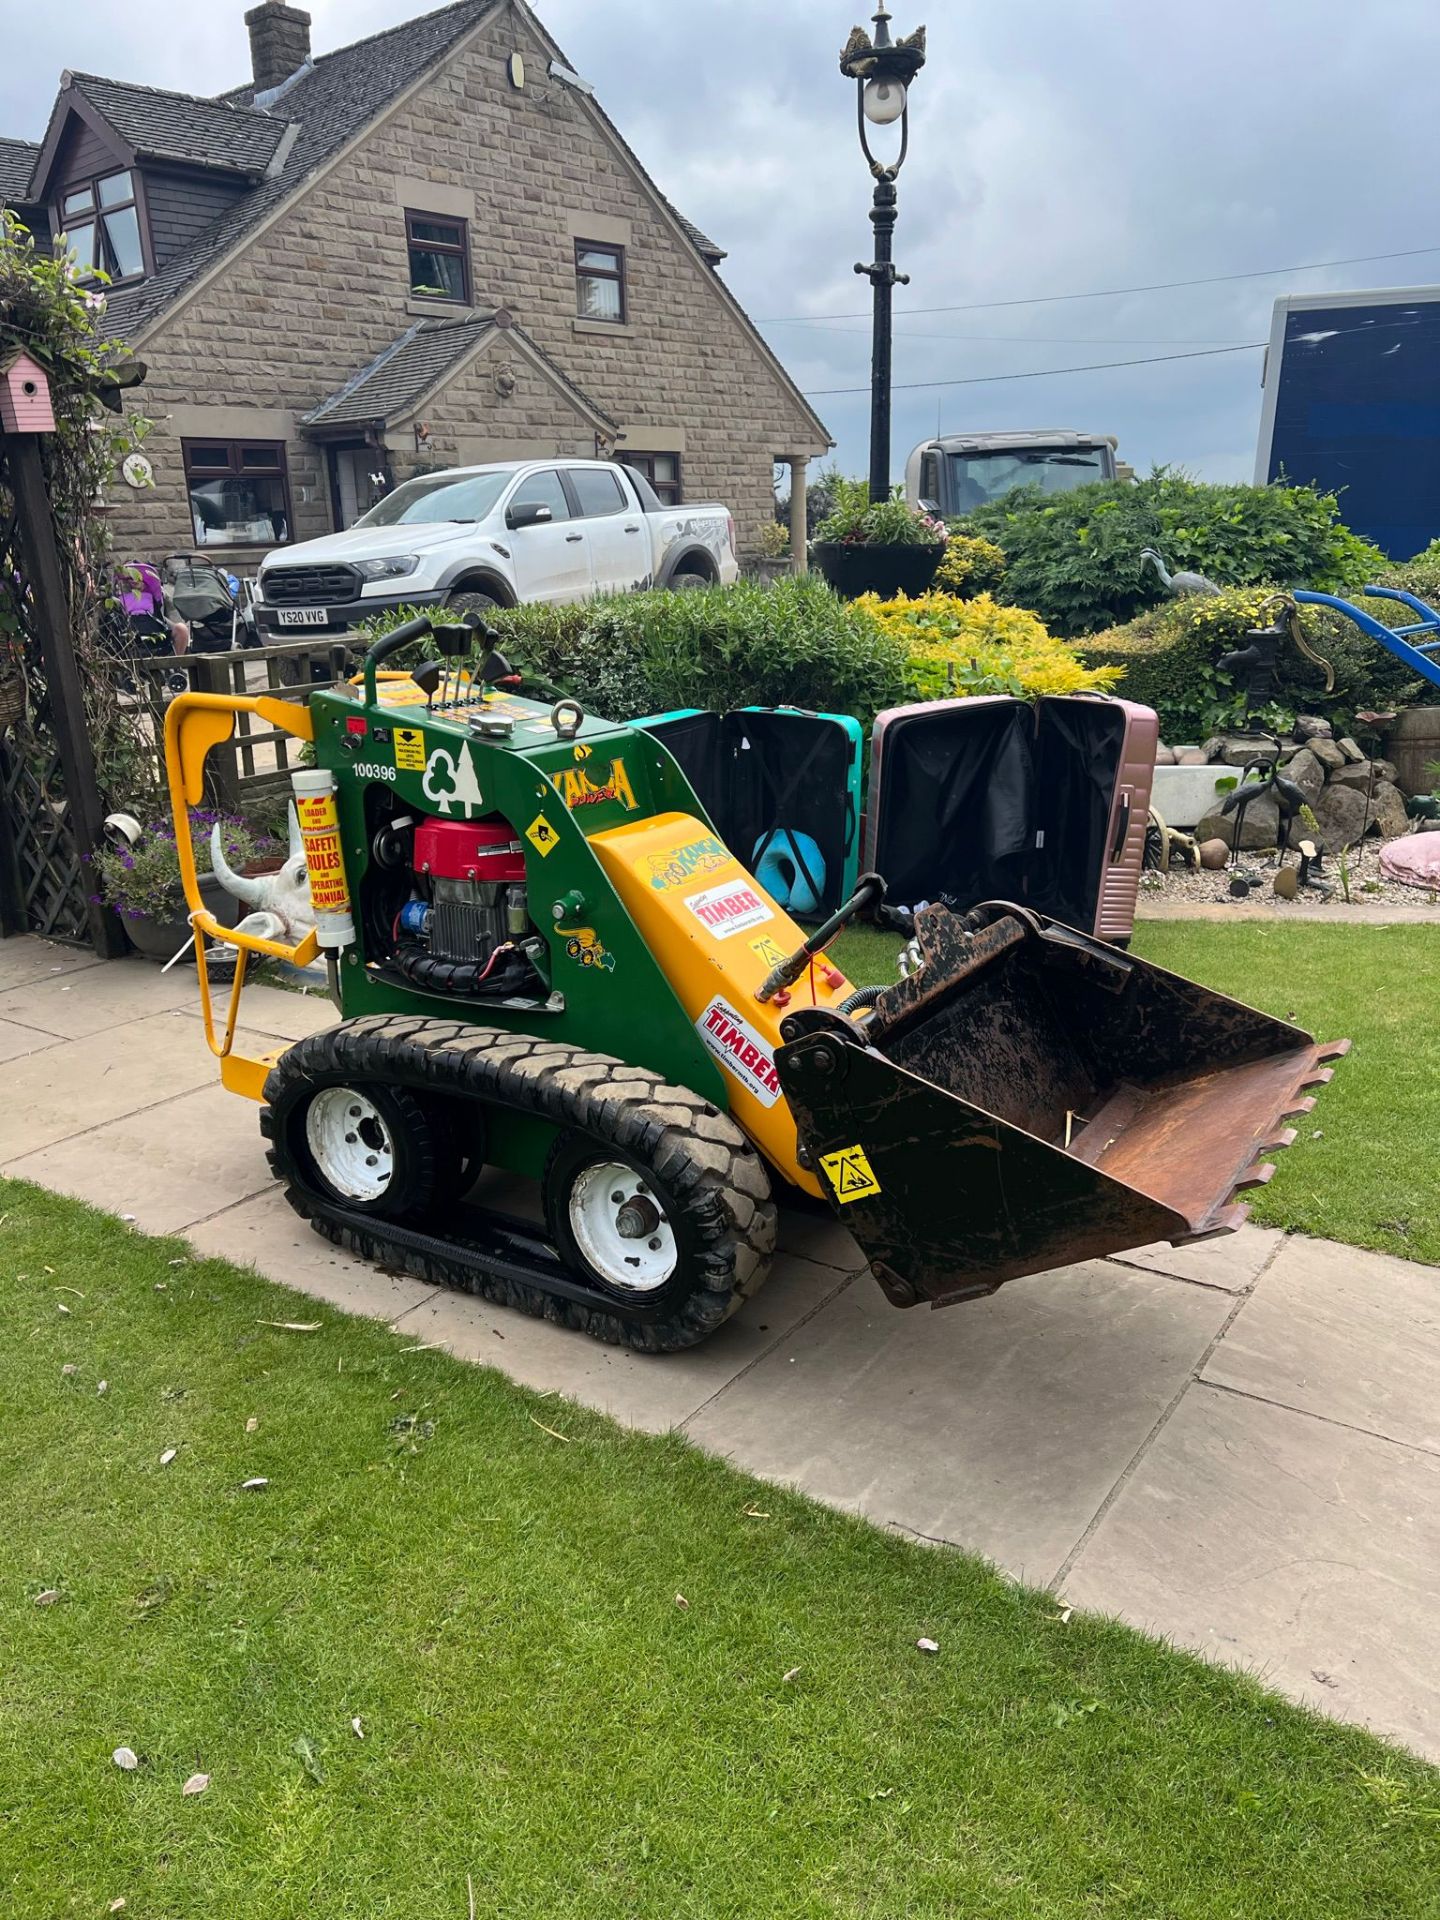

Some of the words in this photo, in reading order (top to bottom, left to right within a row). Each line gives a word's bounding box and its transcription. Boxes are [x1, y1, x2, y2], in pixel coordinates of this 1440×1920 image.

[281, 611, 304, 623] YS20
[305, 610, 324, 623] VVG
[352, 762, 396, 781] 100396
[304, 807, 327, 817] LOADER
[304, 834, 337, 852] SAFETY
[307, 851, 341, 871] RULES
[311, 877, 344, 889] OPERATING
[312, 889, 346, 904] MANUAL
[695, 890, 763, 927] TIMBER
[703, 1006, 780, 1096] TIMBER
